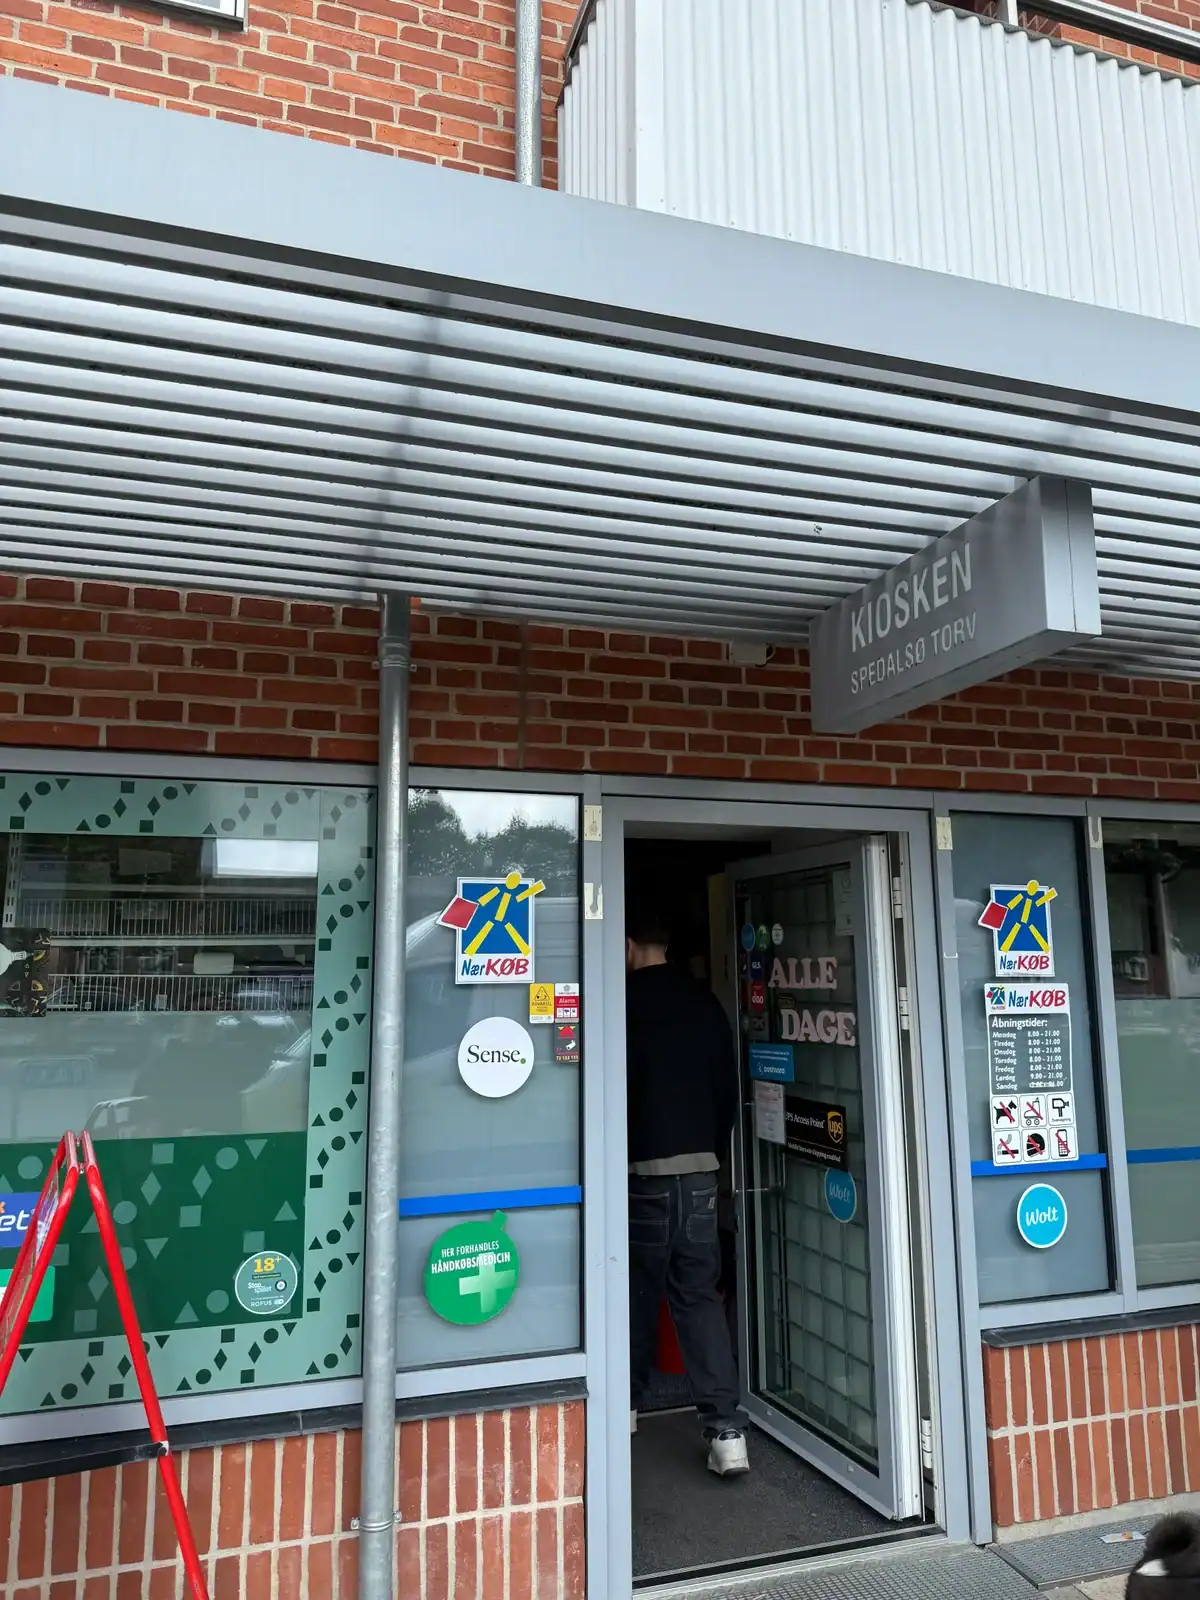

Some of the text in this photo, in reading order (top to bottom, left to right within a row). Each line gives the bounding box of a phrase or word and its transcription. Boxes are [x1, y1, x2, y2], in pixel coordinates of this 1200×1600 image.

[851, 542, 972, 652] KIOSKEN
[850, 612, 976, 694] SPEDALSØ TORV
[461, 957, 529, 977] NærKØB
[1000, 955, 1050, 971] NærKØB
[768, 957, 837, 990] ALLE
[1008, 989, 1066, 1008] NærKØB
[781, 1009, 856, 1046] DAGE
[992, 1016, 1048, 1030] Åbningstider:
[467, 1044, 527, 1065] Sense.
[794, 1114, 810, 1126] Access
[829, 1120, 842, 1137] ups
[829, 1181, 851, 1203] Wolt
[1025, 1206, 1058, 1227] Wolt
[441, 1240, 500, 1258] HER FORHANDLES
[254, 1255, 282, 1273] 18+
[431, 1251, 511, 1275] HÅNDKØBSMEDICIN
